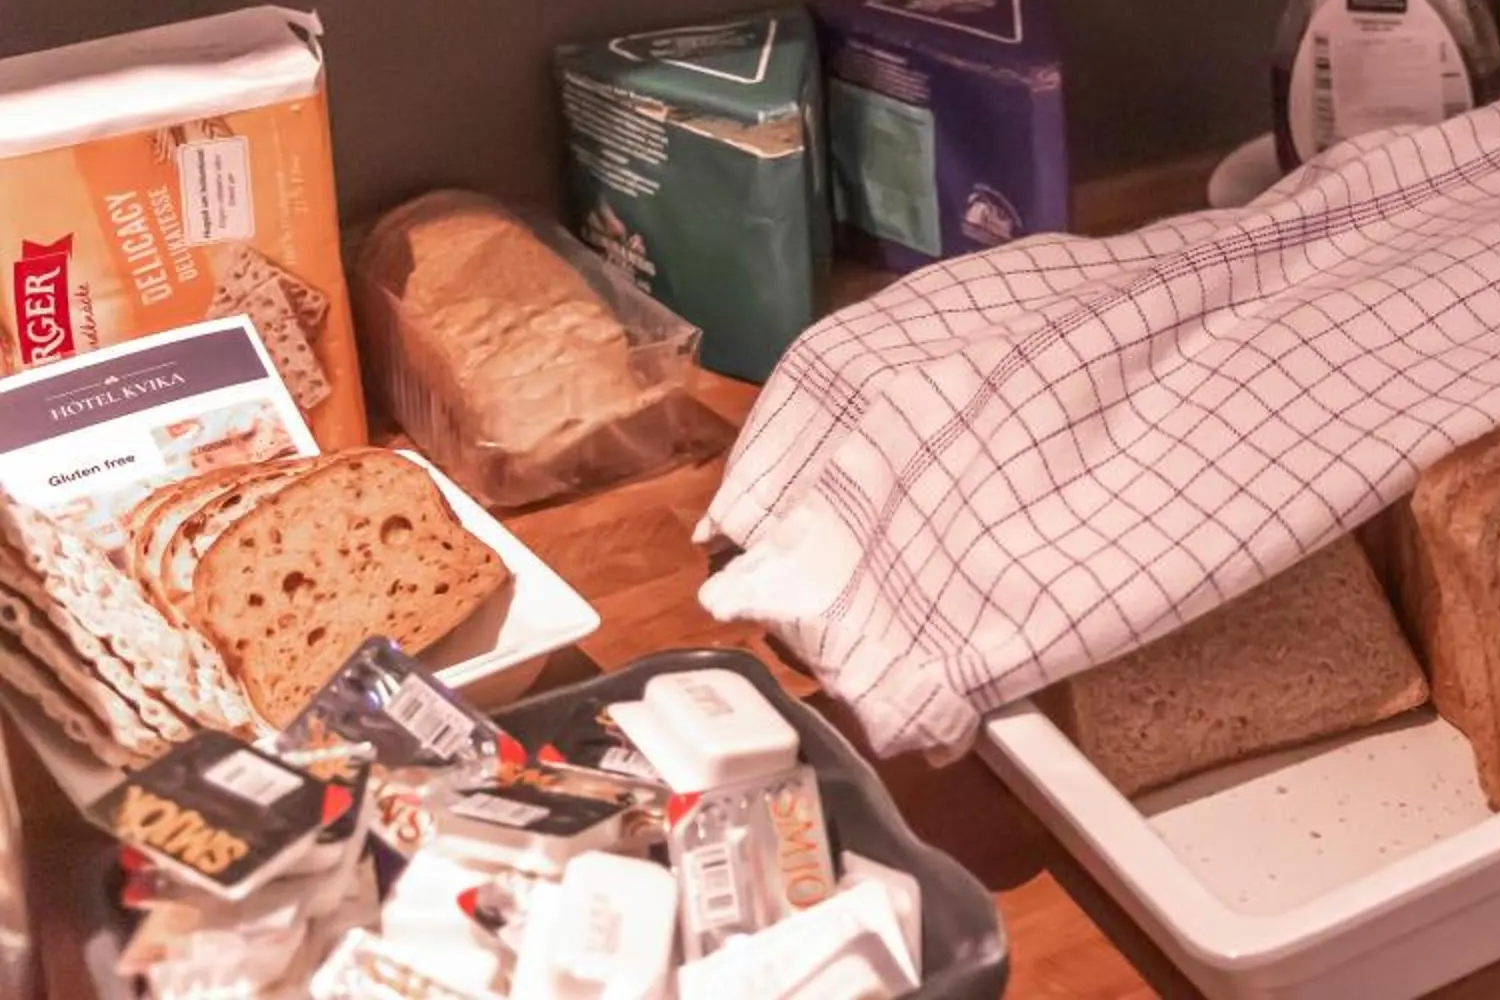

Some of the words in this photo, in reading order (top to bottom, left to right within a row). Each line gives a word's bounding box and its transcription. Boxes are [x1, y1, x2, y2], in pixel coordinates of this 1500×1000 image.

[104, 189, 174, 306] DELICACY
[148, 184, 199, 283] DELIKATESSE
[50, 391, 121, 421] HOTEL
[125, 371, 187, 399] KVIKA
[48, 464, 102, 488] Gluten
[104, 453, 137, 471] free
